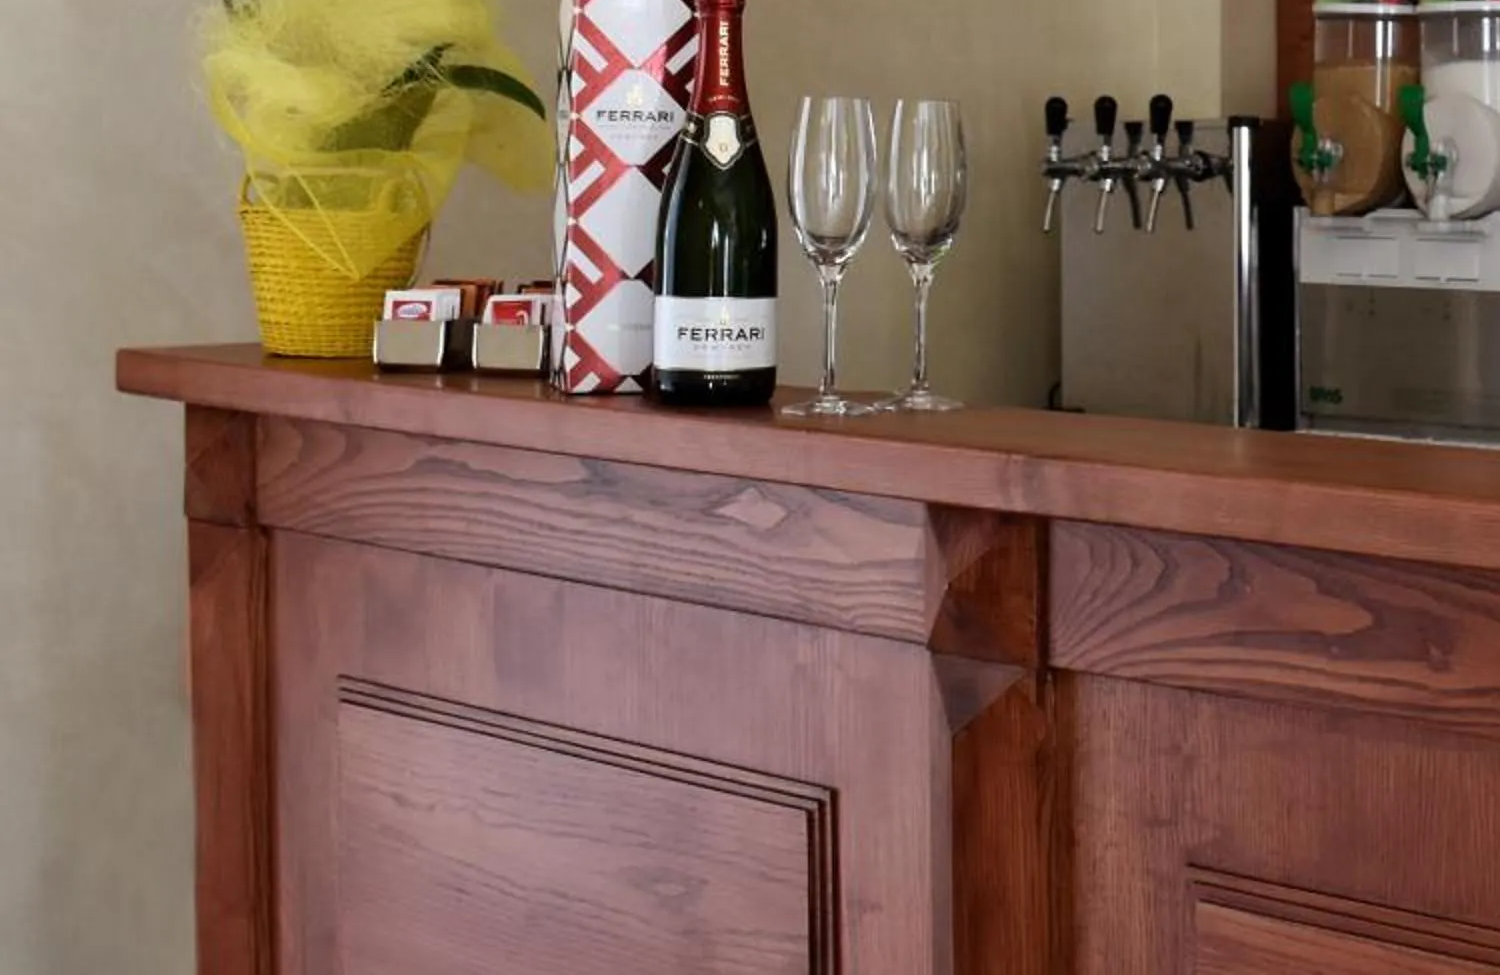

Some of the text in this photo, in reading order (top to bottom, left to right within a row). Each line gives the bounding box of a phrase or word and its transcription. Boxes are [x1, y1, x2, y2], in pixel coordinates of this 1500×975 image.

[718, 20, 730, 87] FERRARI
[596, 110, 675, 122] FERRARI
[677, 327, 766, 341] FERRARI
